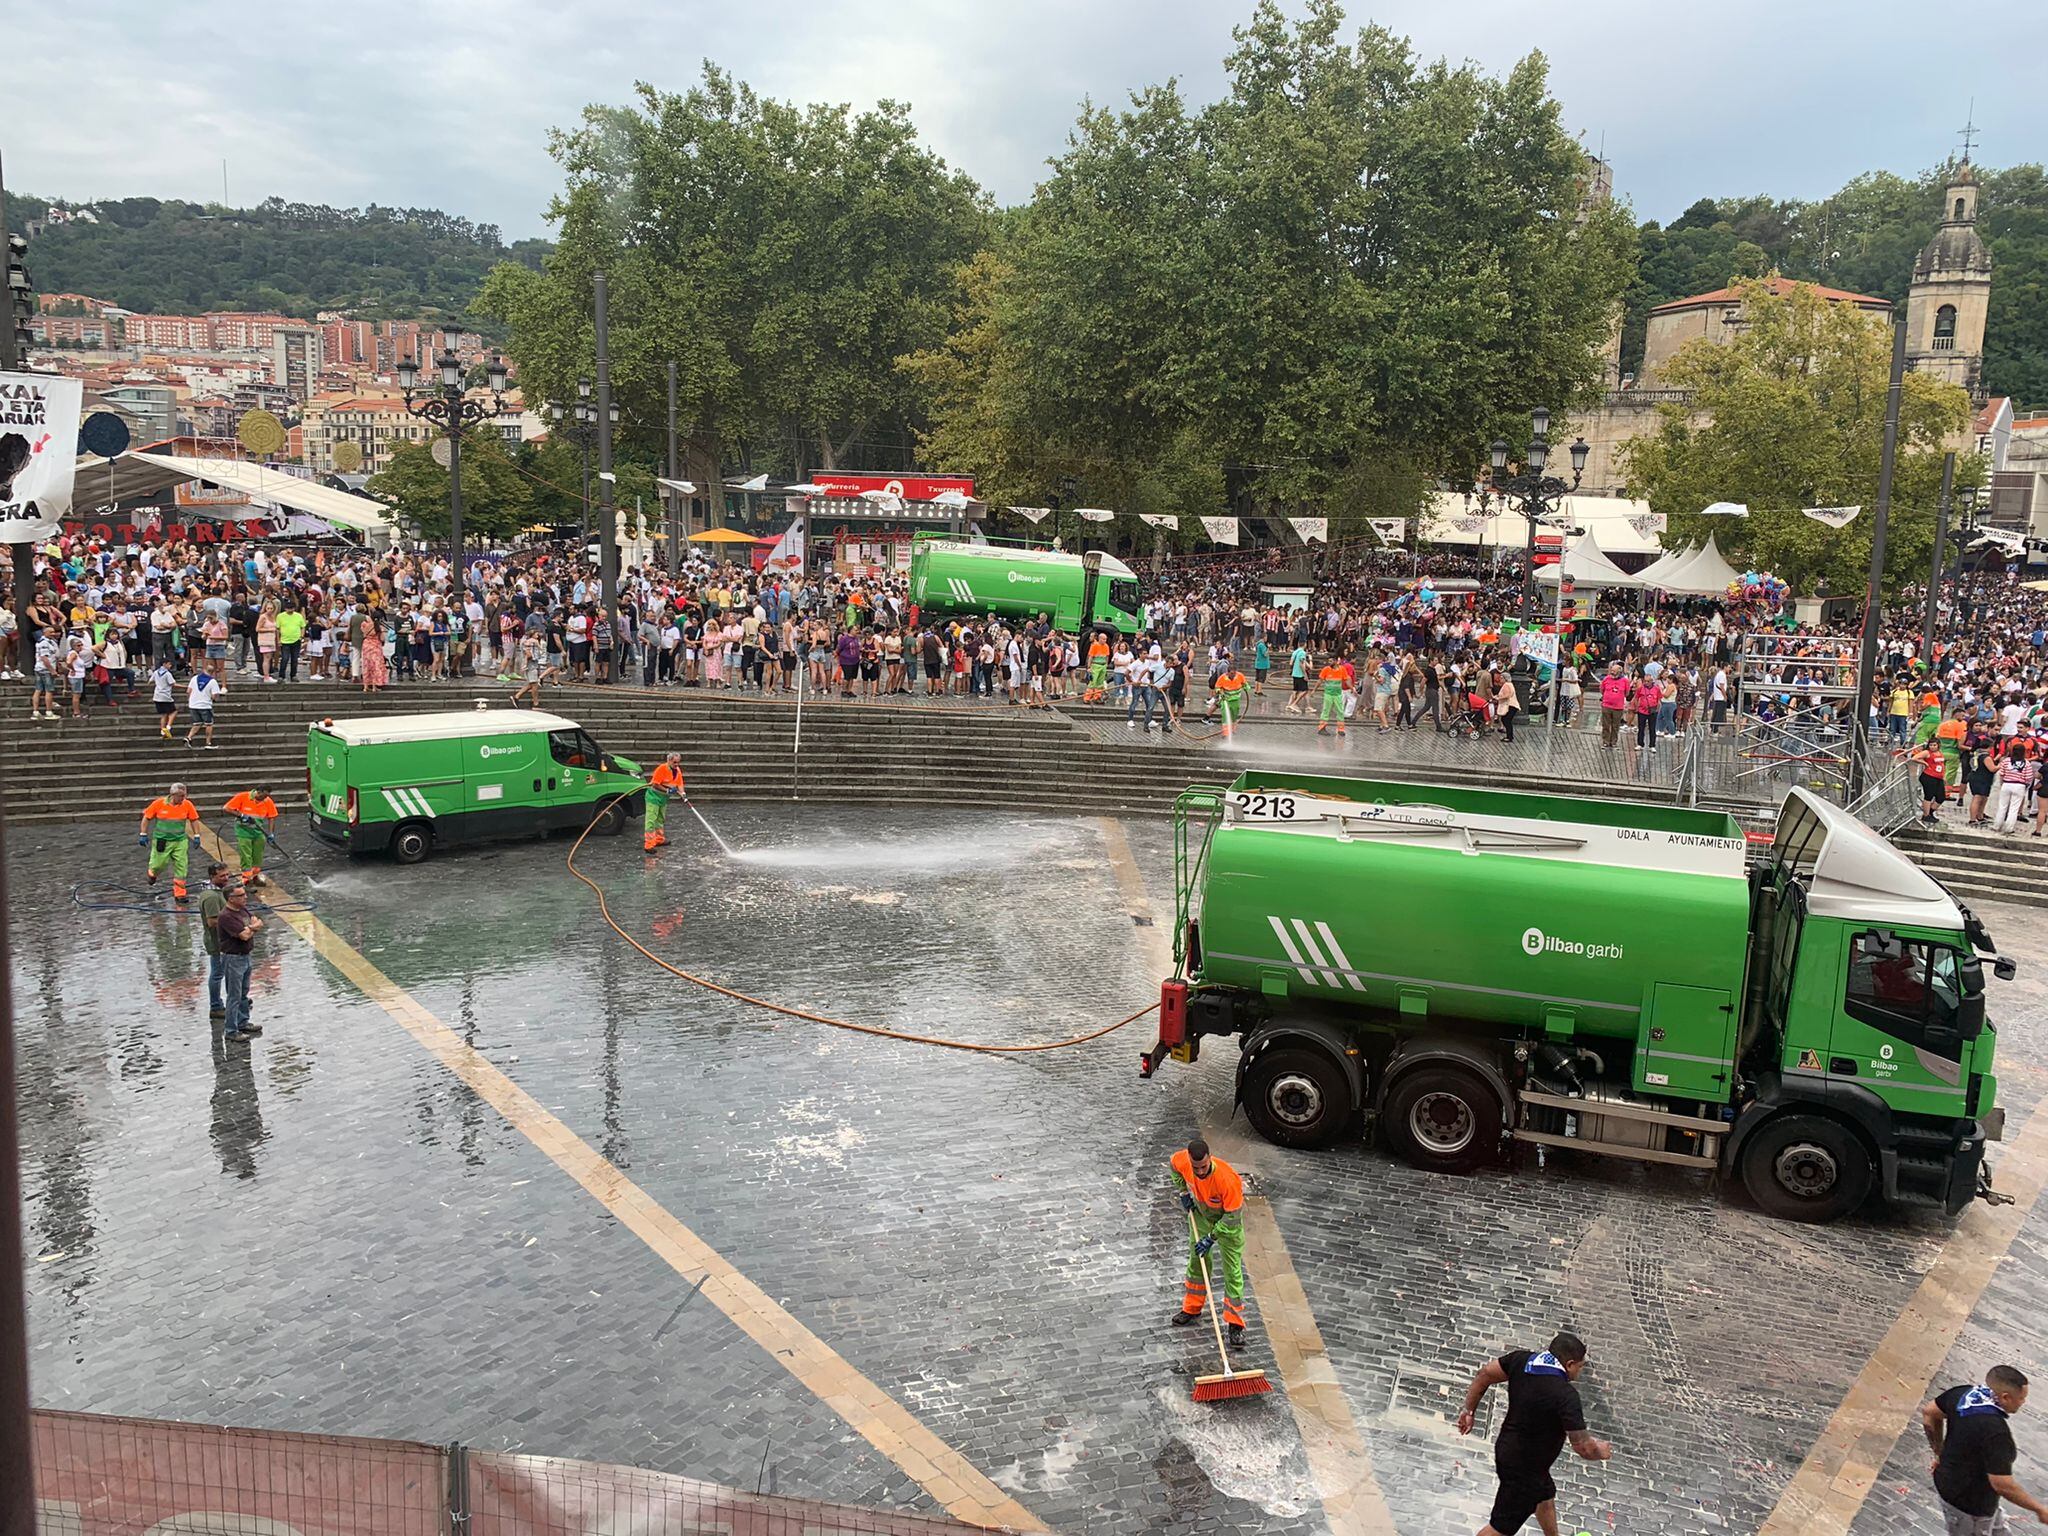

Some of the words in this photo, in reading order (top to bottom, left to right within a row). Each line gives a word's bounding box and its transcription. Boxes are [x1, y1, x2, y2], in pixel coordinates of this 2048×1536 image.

[10, 401, 46, 413] ETA
[1236, 794, 1295, 818] 2213
[1617, 829, 1650, 841] UDALA
[1667, 834, 1743, 851] AYUNTAMIENTO
[1522, 928, 1584, 955] Bilbao
[1586, 943, 1624, 959] garbi
[1871, 1060, 1898, 1071] Bilbao
